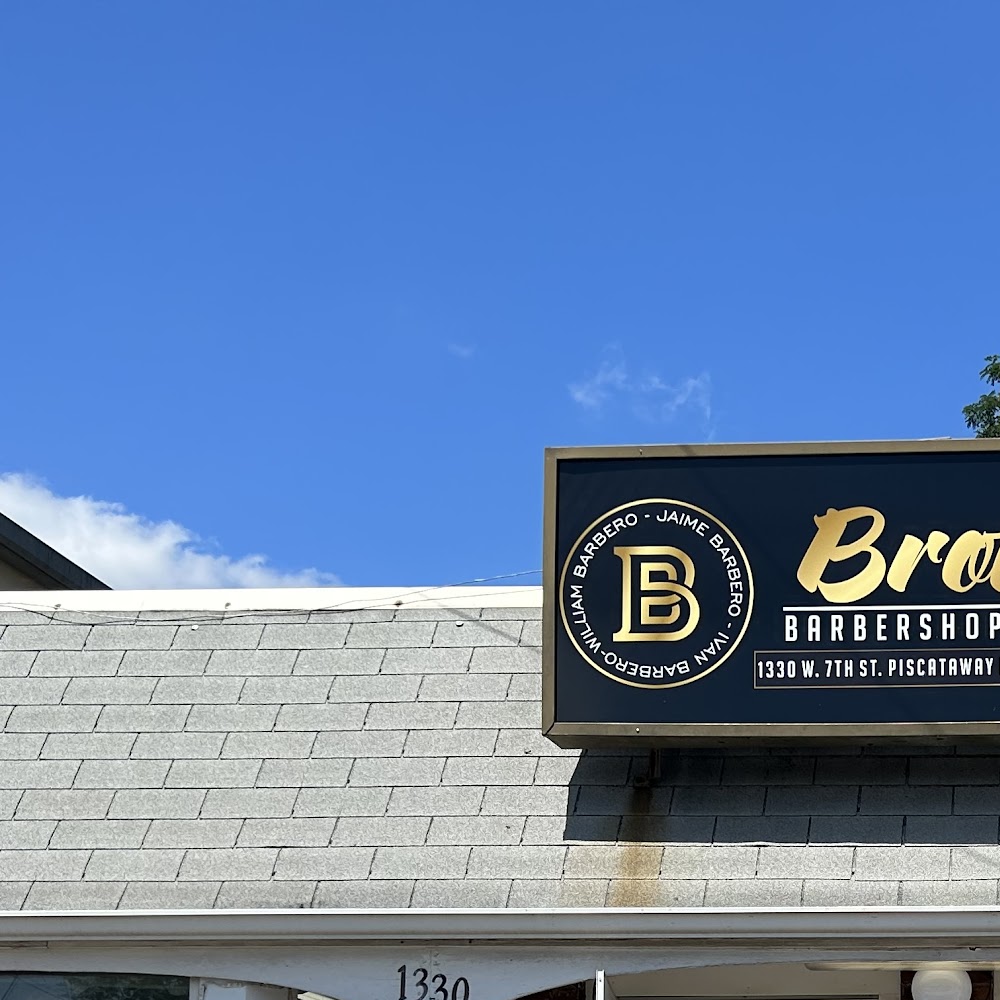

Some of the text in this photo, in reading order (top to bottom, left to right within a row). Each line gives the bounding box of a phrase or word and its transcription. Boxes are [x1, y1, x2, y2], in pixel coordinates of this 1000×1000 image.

[573, 513, 638, 579] BARBERO
[656, 509, 710, 537] JAIME
[708, 533, 743, 618] BARBERO
[570, 584, 602, 654] WILLIAM
[693, 631, 730, 666] IVAN
[757, 660, 796, 679] 1330
[801, 660, 820, 678] W.
[824, 659, 854, 678] 7TH
[859, 658, 883, 677] ST.
[888, 657, 994, 677] PISCATAWAY
